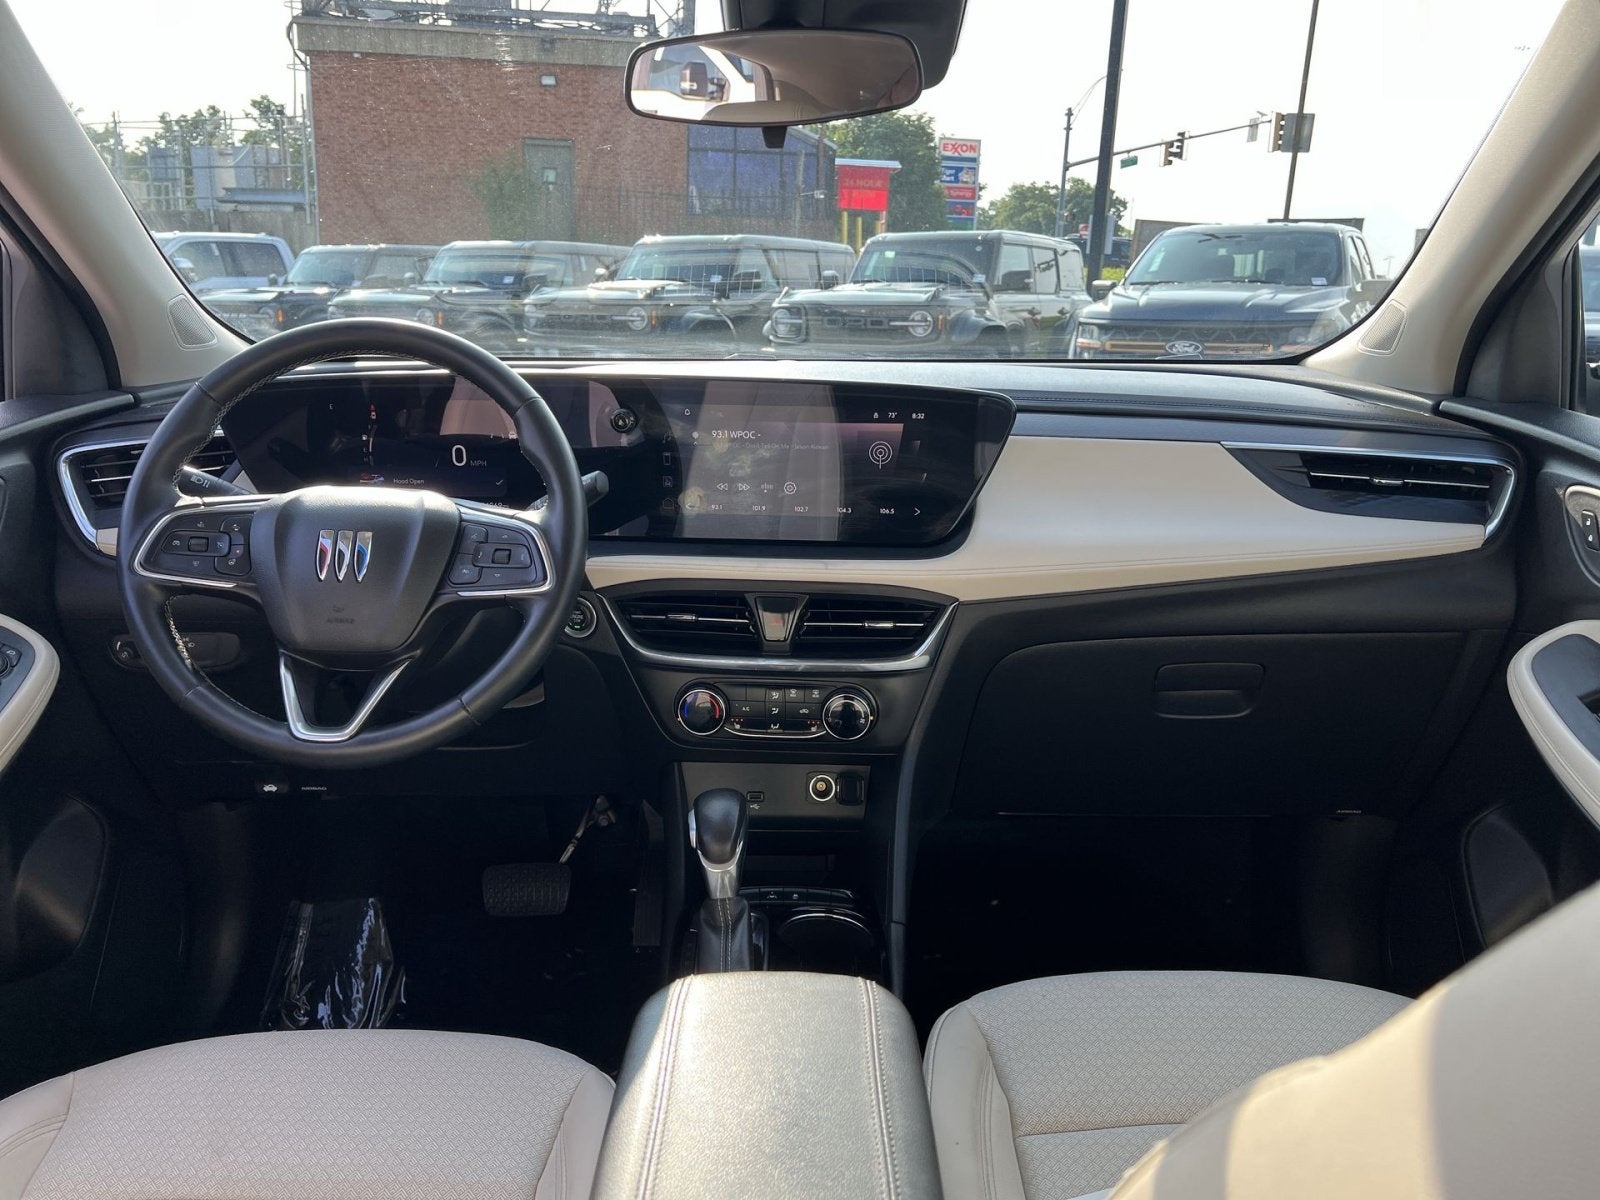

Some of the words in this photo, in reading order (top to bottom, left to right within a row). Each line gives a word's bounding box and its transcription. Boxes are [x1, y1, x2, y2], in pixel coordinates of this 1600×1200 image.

[943, 142, 977, 156] EXXON
[711, 430, 728, 439] 93.1
[729, 430, 756, 439] WPOC
[452, 444, 467, 466] 0
[470, 459, 487, 467] MPH
[393, 477, 409, 485] Hood
[409, 478, 425, 486] Open
